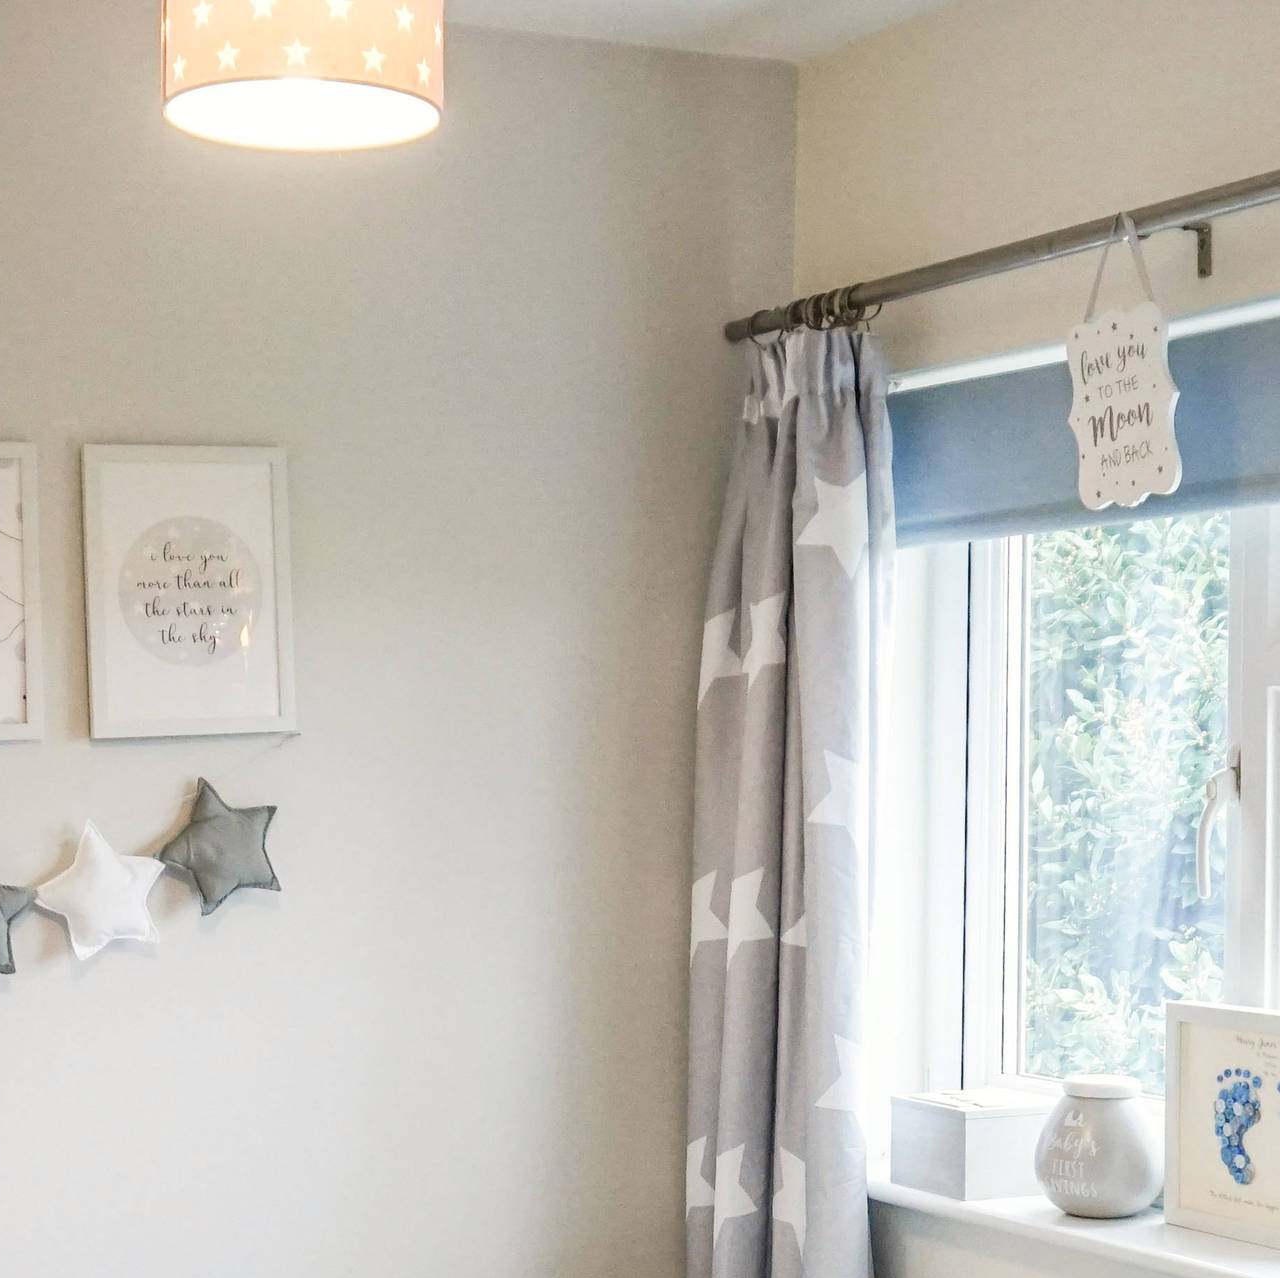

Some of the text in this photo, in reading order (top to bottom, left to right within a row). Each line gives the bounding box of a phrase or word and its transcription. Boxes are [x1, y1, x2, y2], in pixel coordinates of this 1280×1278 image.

[1080, 342, 1148, 385] love you
[1097, 375, 1139, 400] TO THE
[1101, 440, 1153, 469] AND BACK
[163, 541, 194, 563] love
[200, 553, 229, 572] you
[136, 568, 241, 590] more than all
[145, 596, 237, 617] the stars in
[160, 624, 216, 653] the sky
[1048, 1159, 1086, 1178] FIRST
